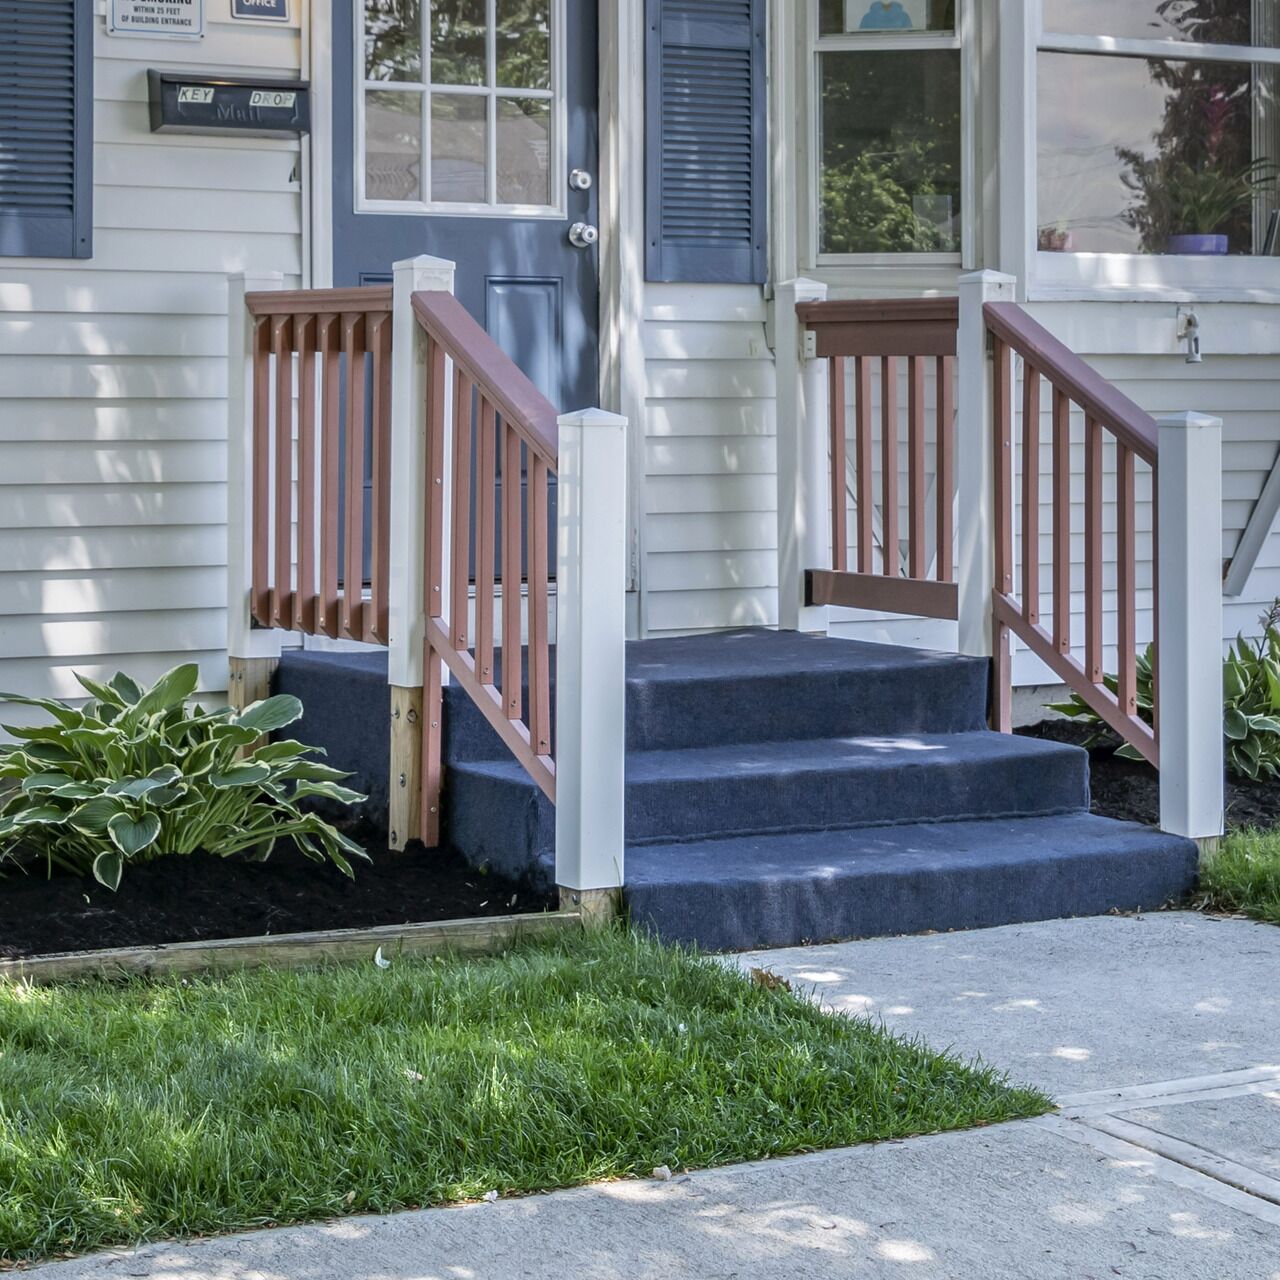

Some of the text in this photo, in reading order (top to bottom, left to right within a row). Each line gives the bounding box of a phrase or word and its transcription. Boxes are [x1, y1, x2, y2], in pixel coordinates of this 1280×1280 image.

[133, 6, 181, 16] WITHIN 25 FEET
[121, 15, 192, 27] OF BUILDING ENTRANCE
[180, 88, 293, 106] KEY DROP
